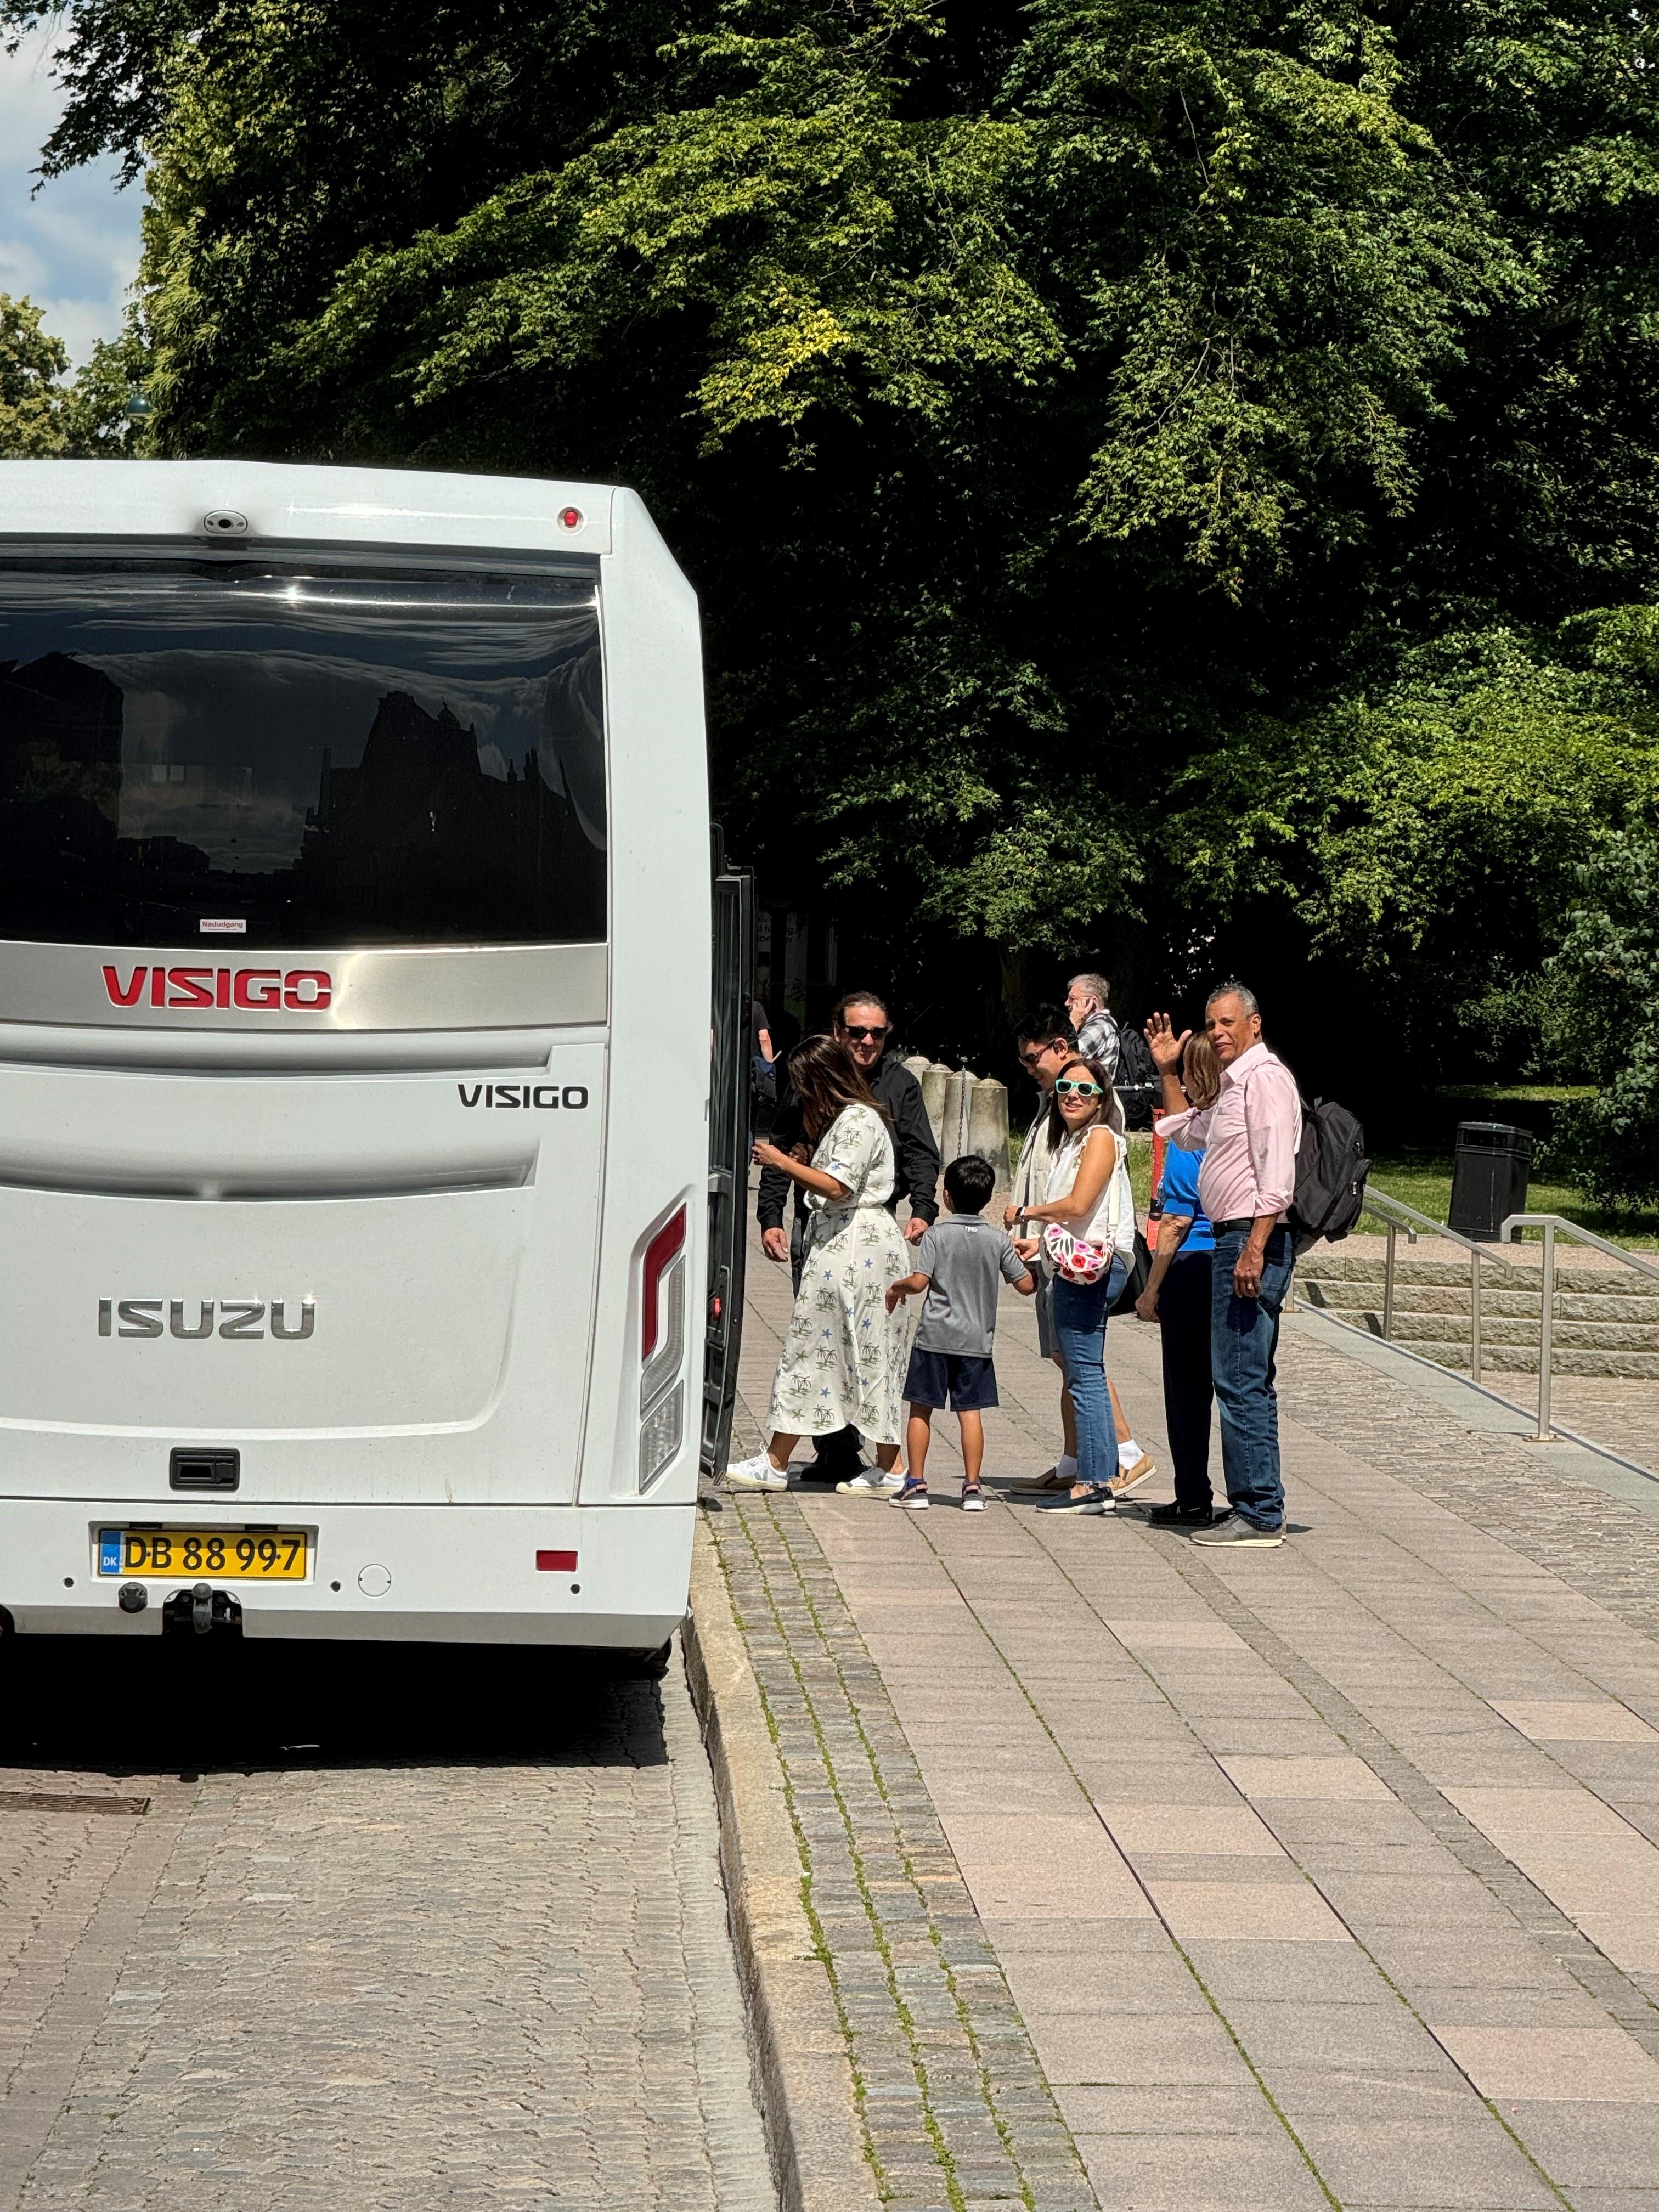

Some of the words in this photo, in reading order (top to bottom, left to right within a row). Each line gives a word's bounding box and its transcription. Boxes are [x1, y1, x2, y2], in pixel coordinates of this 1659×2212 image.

[102, 966, 331, 1012] VISIGO
[457, 1084, 588, 1109] VISIGO
[99, 1297, 315, 1339] ISUZU
[103, 1556, 117, 1566] DK
[125, 1537, 172, 1569] DB
[183, 1537, 225, 1571] 88
[236, 1538, 300, 1572] 997
